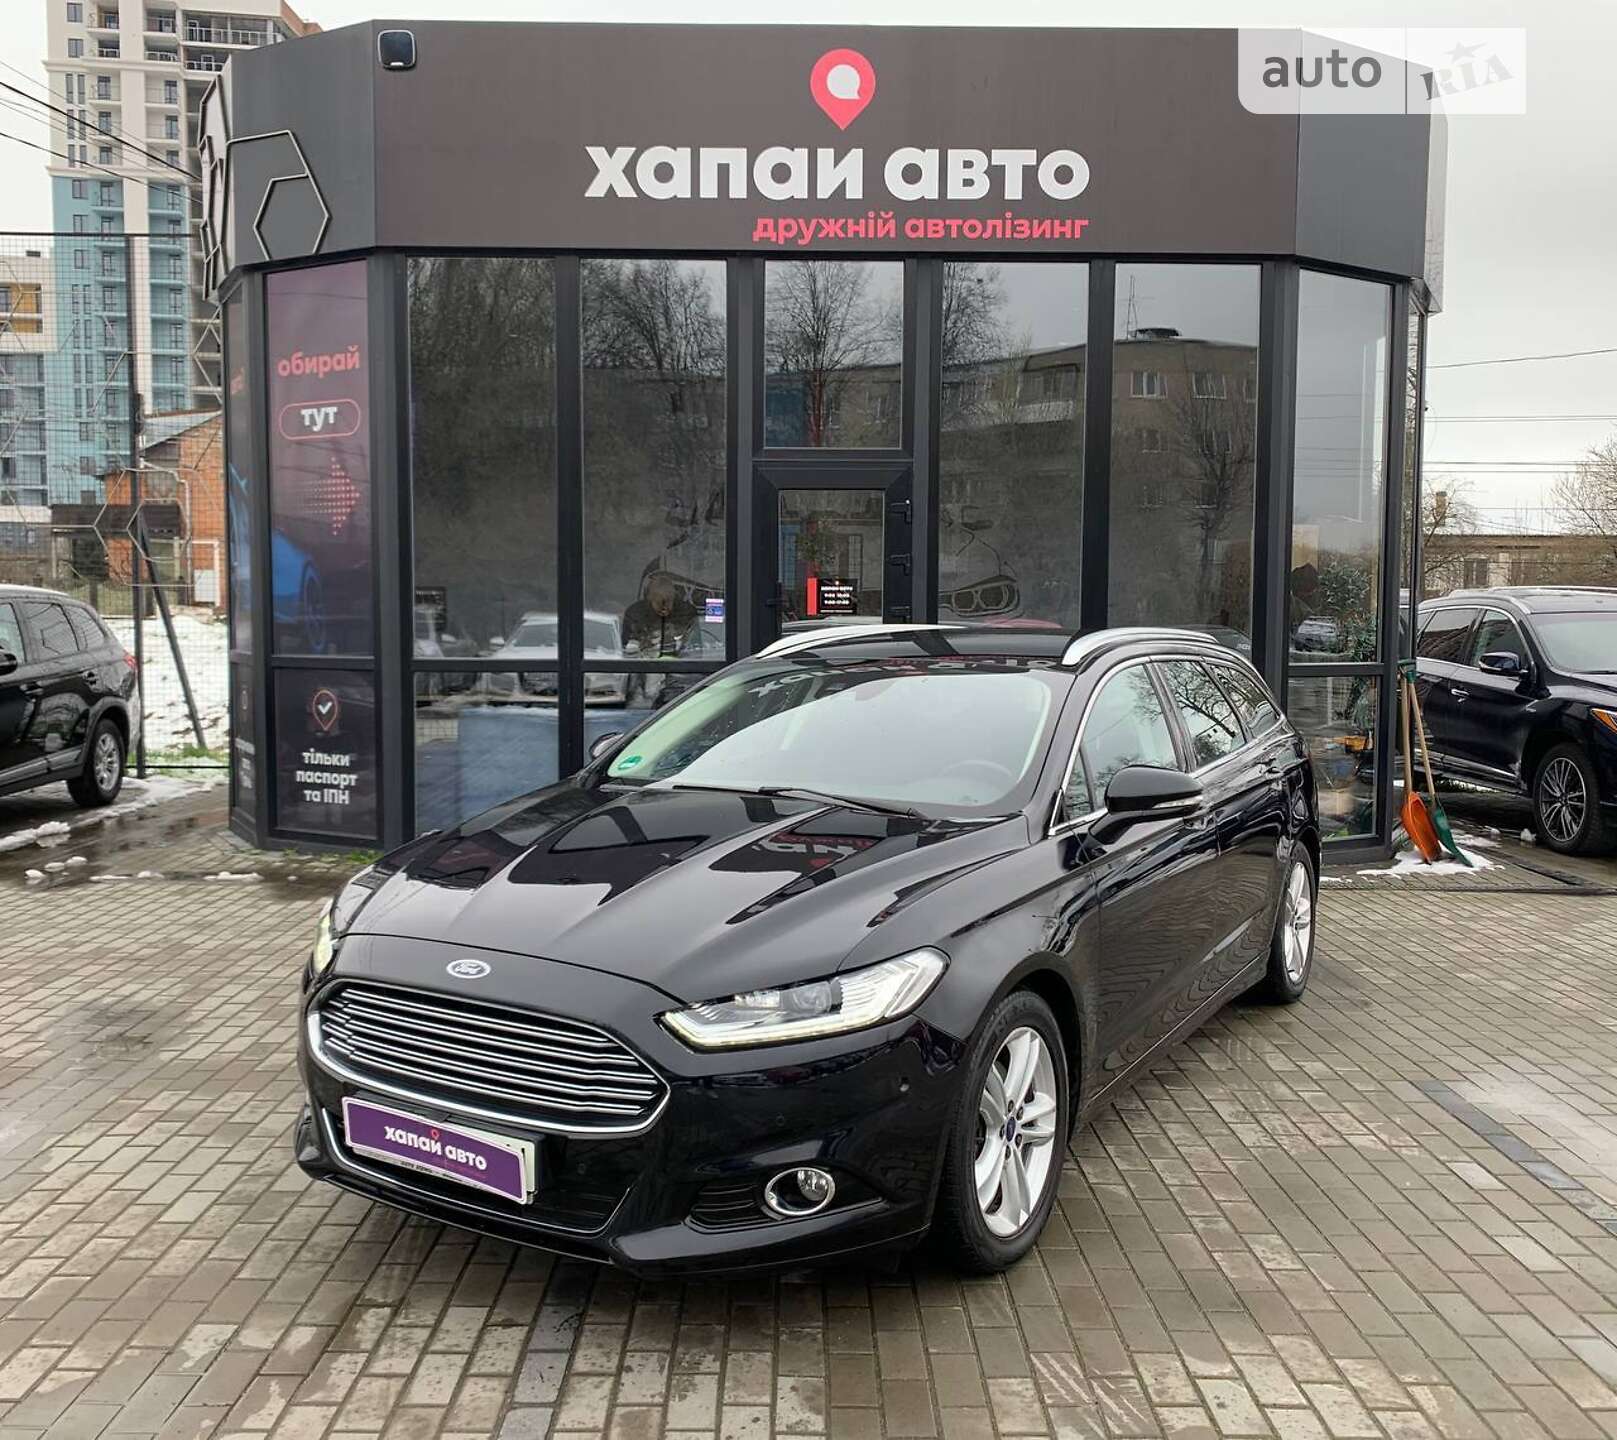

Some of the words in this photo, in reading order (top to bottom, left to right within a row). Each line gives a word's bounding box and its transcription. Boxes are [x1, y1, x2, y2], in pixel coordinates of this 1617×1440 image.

[884, 146, 1090, 201] авто
[752, 211, 897, 244] дружній
[904, 212, 1090, 240] автолізинг
[277, 345, 360, 378] обирай
[301, 406, 338, 432] тут
[302, 748, 350, 767] тільки
[295, 770, 358, 788] паспорт
[304, 789, 321, 802] та
[323, 788, 350, 804] ІПН
[445, 1145, 487, 1171] авто
